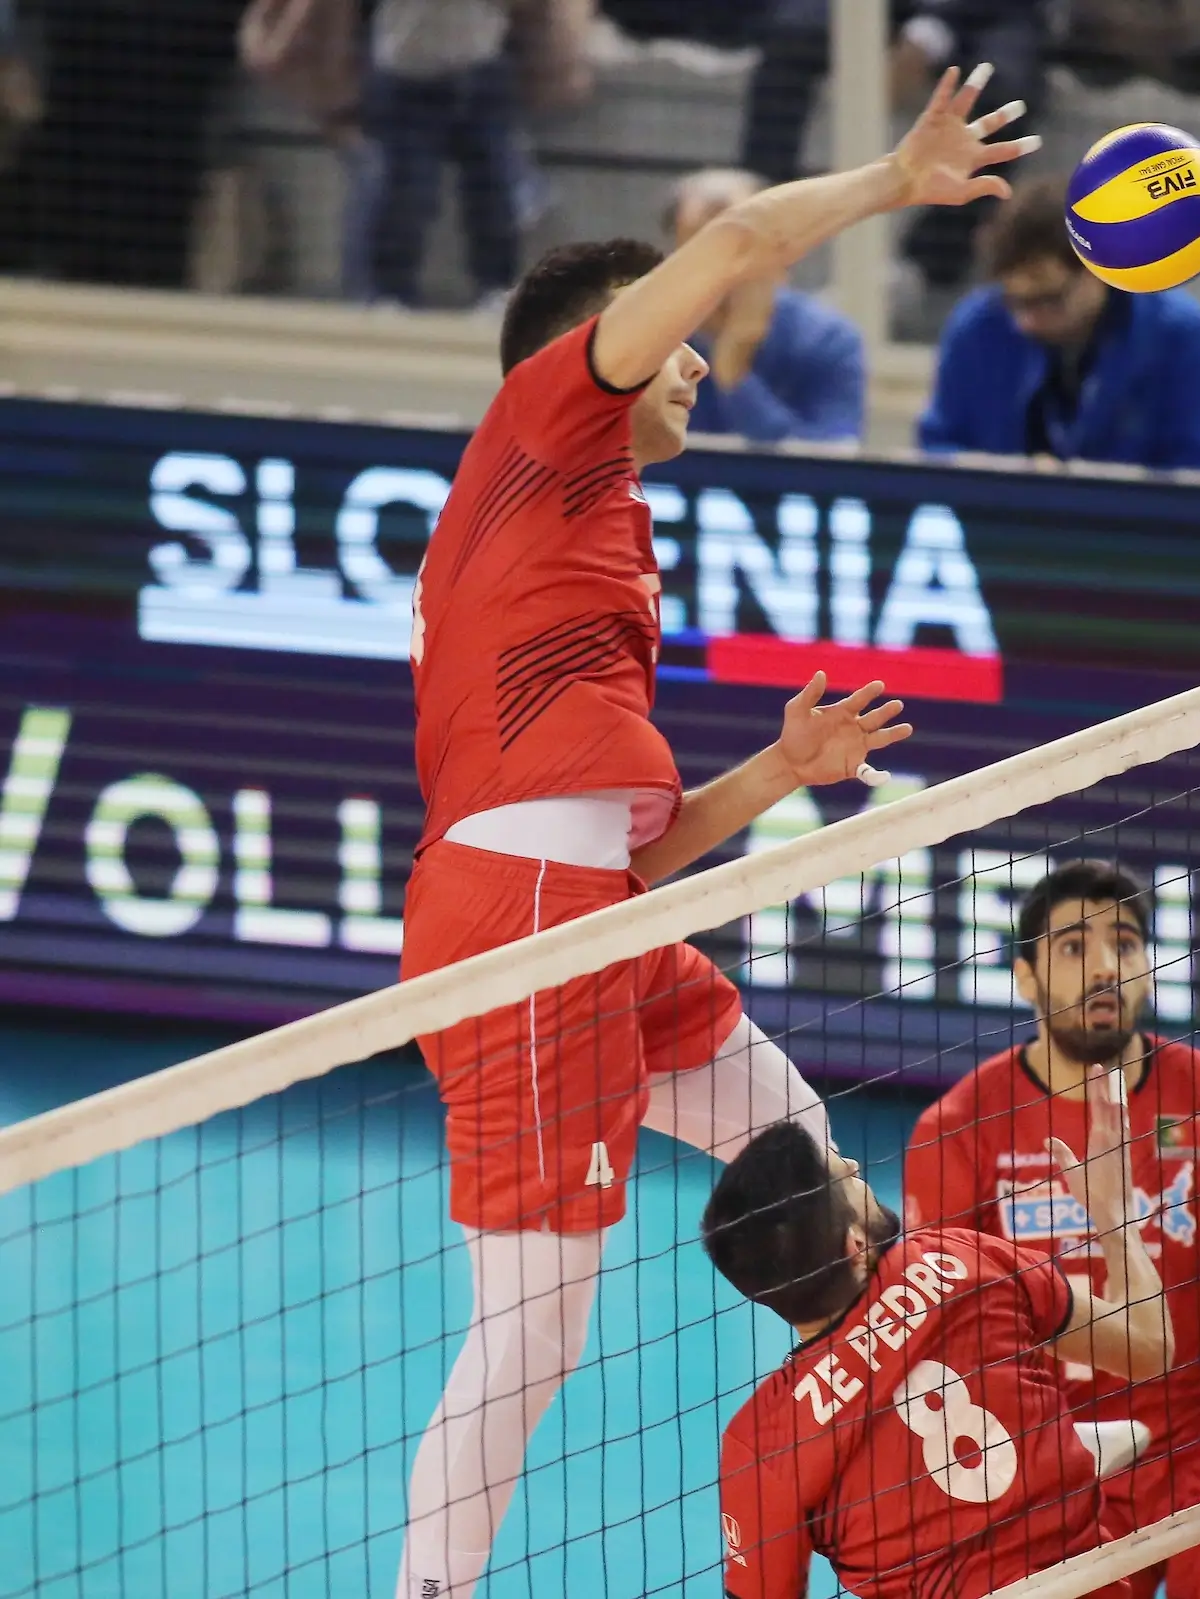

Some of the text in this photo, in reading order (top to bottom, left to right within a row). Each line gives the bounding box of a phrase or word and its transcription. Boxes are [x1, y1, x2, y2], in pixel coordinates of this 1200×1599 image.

[1147, 169, 1197, 200] FIVB
[148, 451, 999, 655] SLOENIA
[584, 1141, 615, 1189] 4
[793, 1353, 864, 1426] ZE
[845, 1251, 969, 1373] PEDRO
[893, 1359, 1018, 1503] 8
